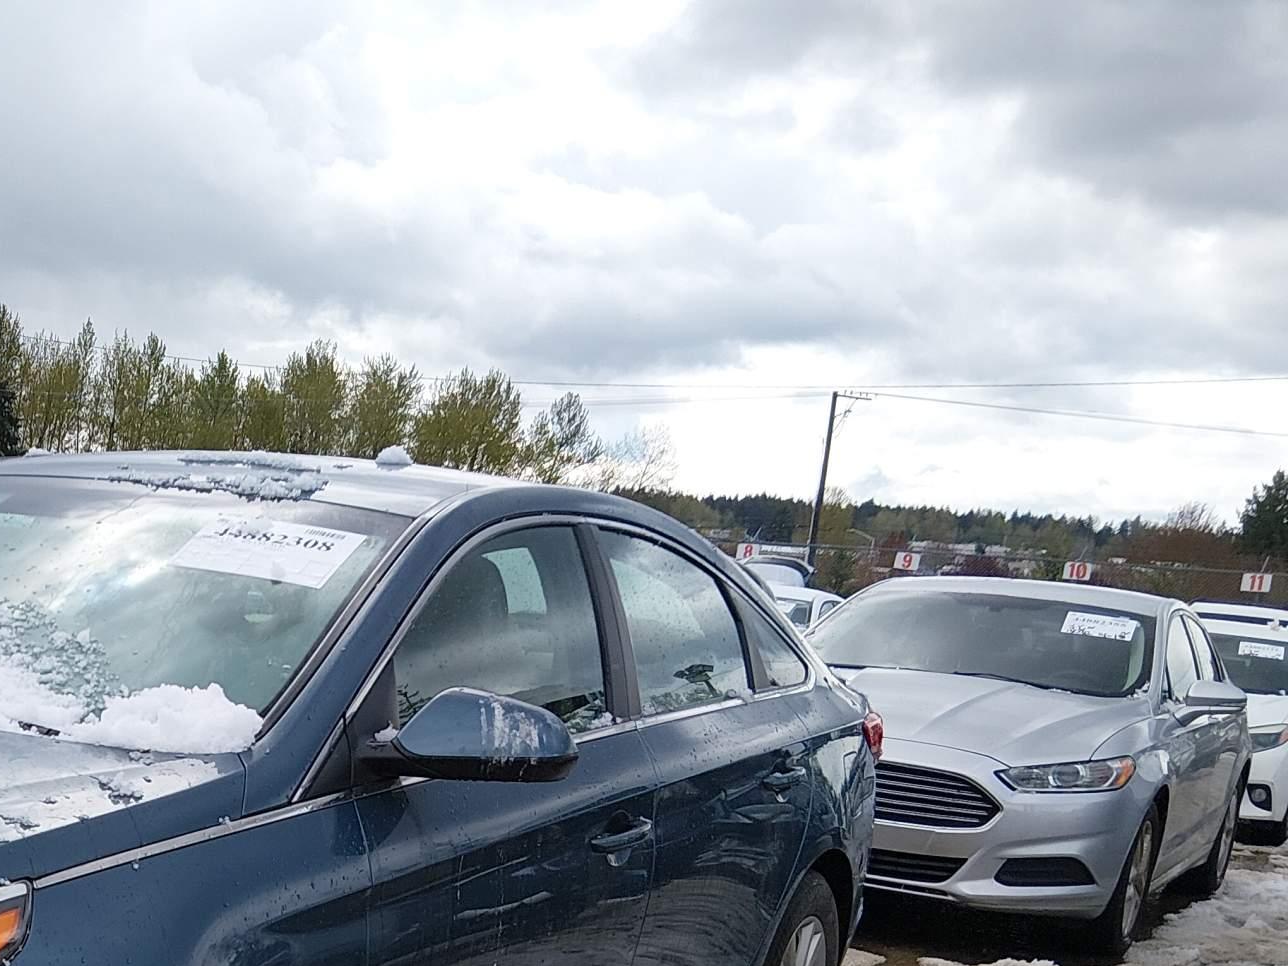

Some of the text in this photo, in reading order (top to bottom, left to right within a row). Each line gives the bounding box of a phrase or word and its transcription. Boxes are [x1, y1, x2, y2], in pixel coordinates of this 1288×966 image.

[743, 545, 754, 559] 8
[902, 553, 912, 569] 9
[1069, 563, 1088, 579] 10
[1249, 575, 1265, 591] 11
